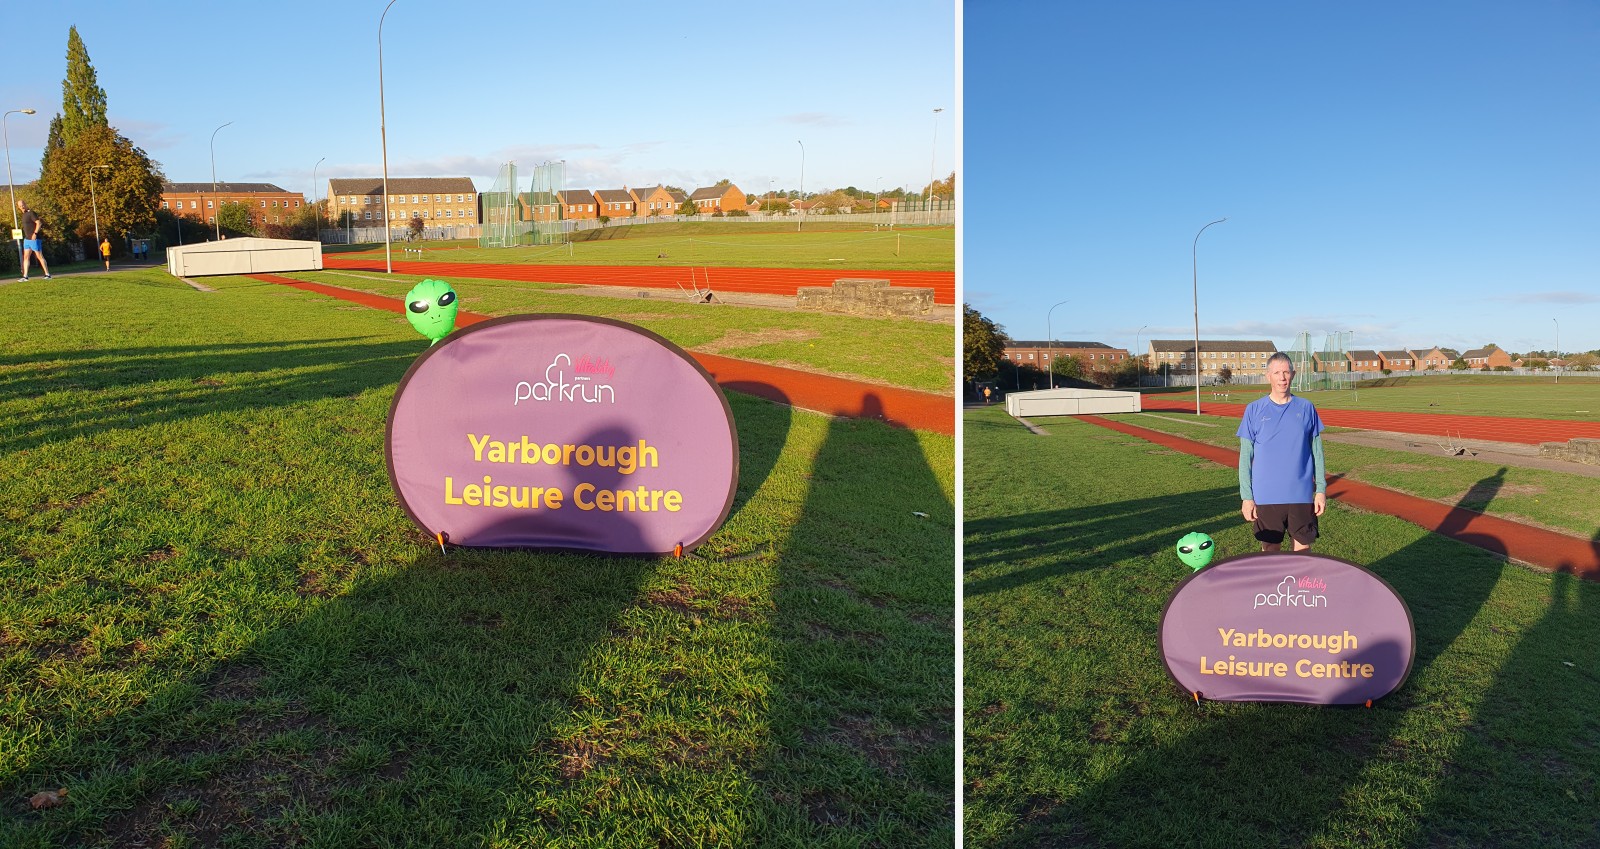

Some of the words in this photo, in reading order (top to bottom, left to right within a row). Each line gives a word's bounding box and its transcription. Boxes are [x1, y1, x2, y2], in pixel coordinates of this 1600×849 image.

[575, 353, 615, 380] Vitality
[514, 370, 615, 405] parkrun
[467, 433, 659, 475] Yarborough
[445, 475, 564, 510] Leisure
[573, 482, 683, 512] Centre
[1253, 585, 1327, 609] parkrun
[1298, 575, 1327, 593] Vitality
[1218, 627, 1358, 654] Yarborough
[1200, 655, 1288, 677] Leisure
[1295, 658, 1375, 678] Centre
